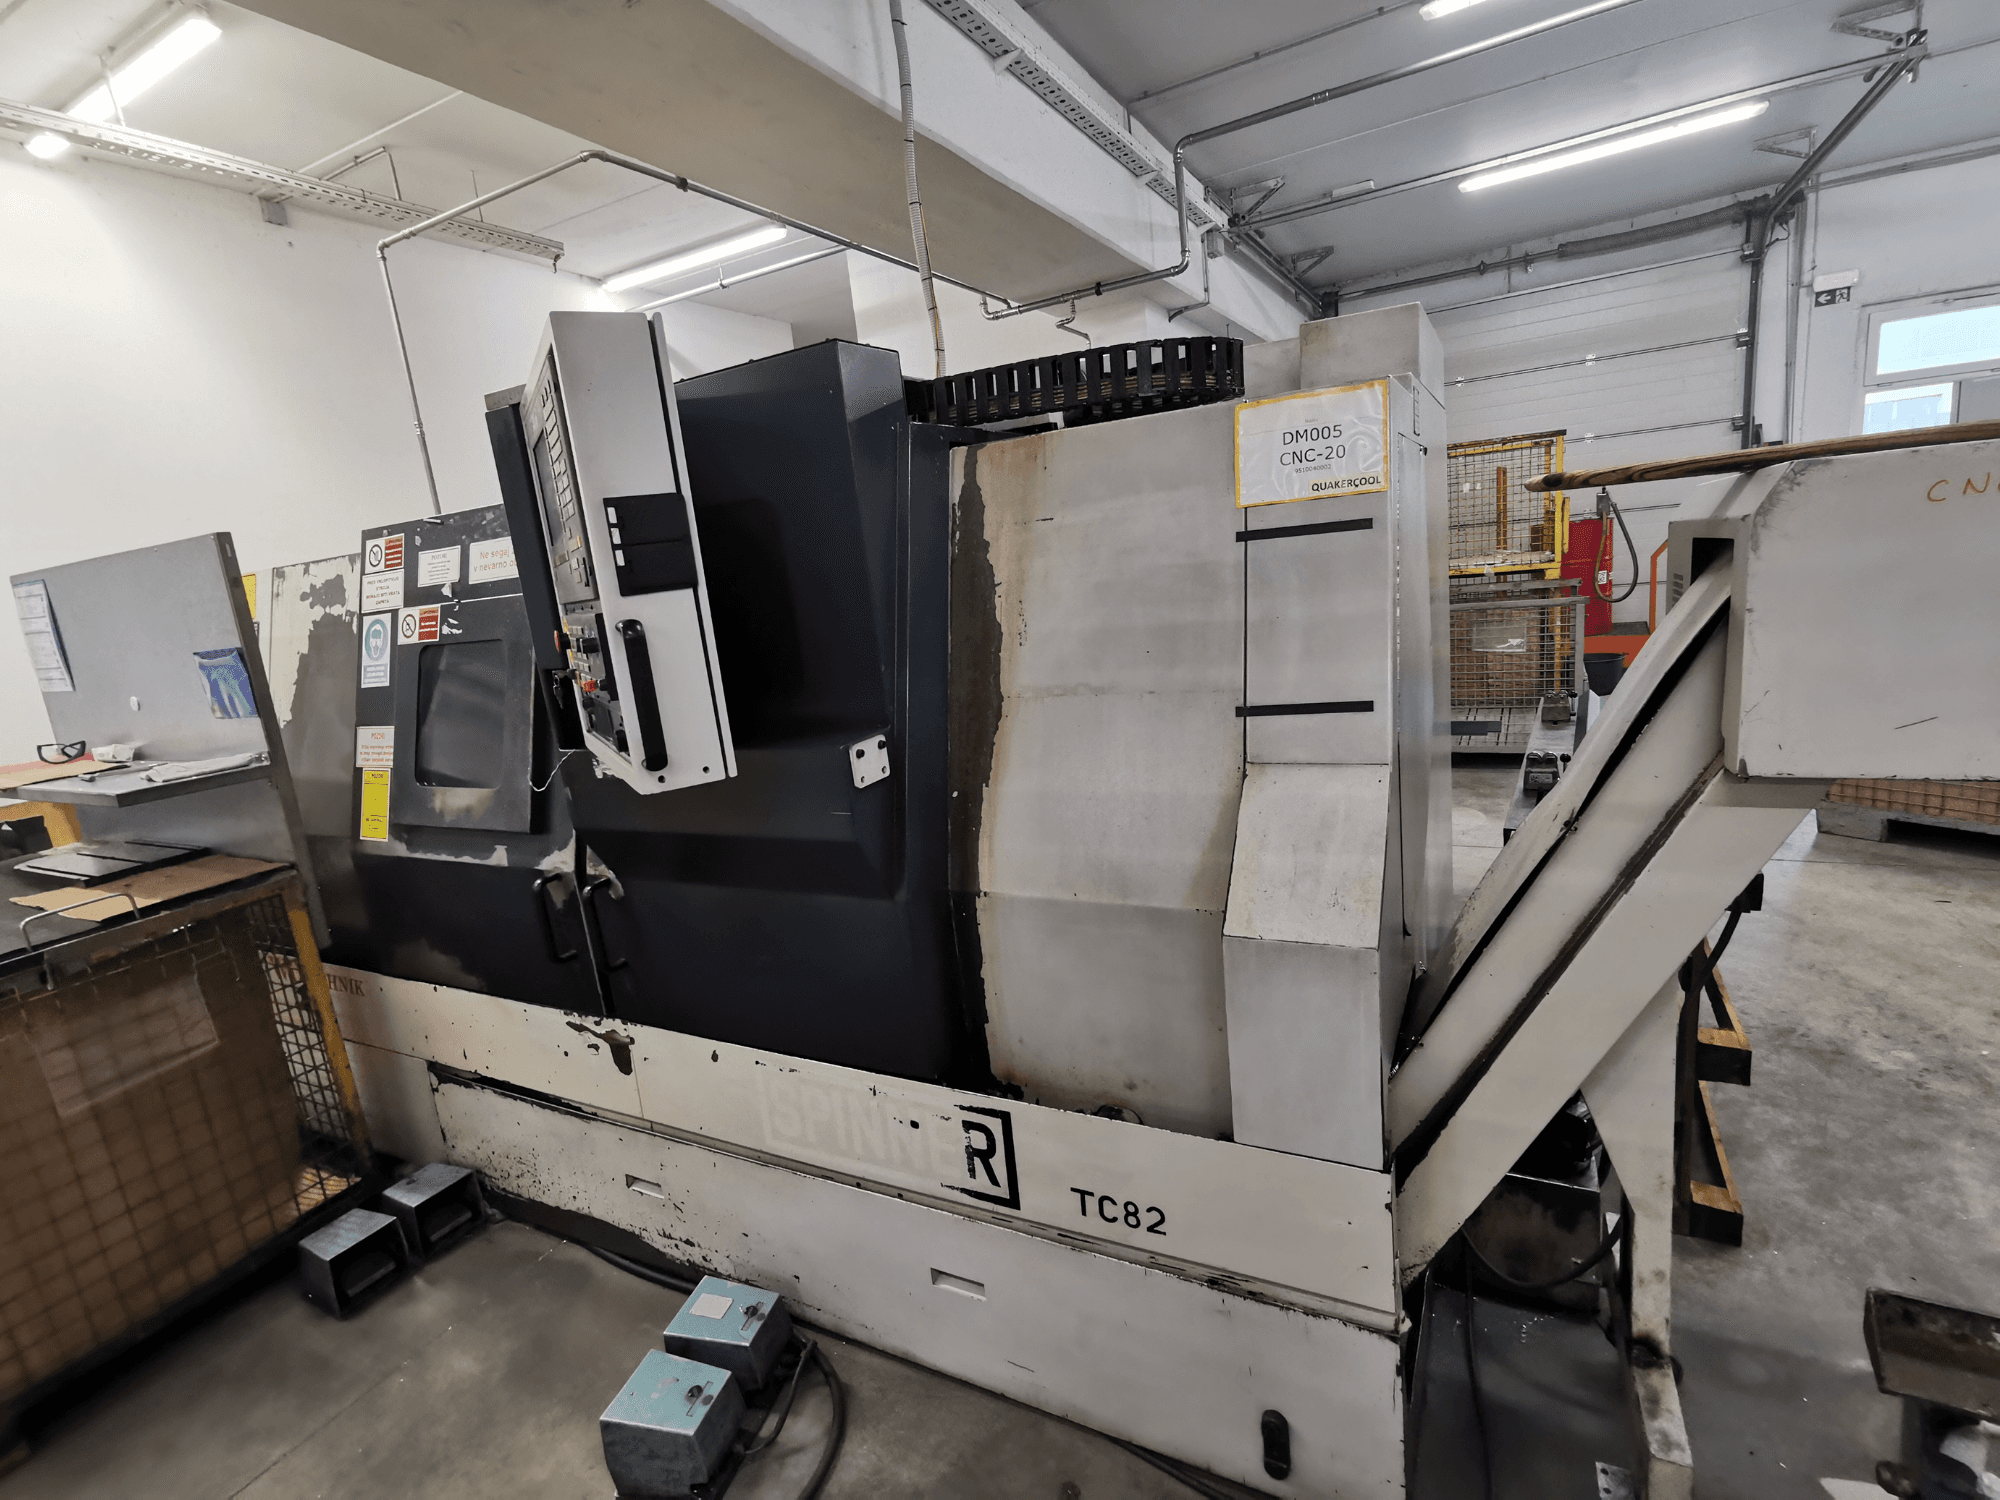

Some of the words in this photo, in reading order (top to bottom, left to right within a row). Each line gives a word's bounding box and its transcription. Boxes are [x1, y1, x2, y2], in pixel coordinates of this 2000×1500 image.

[1283, 424, 1343, 445] DM005
[1280, 445, 1345, 466] CNC-20
[1926, 471, 2000, 502] CN
[326, 973, 365, 997] HNIK
[1069, 1186, 1168, 1236] TC82
